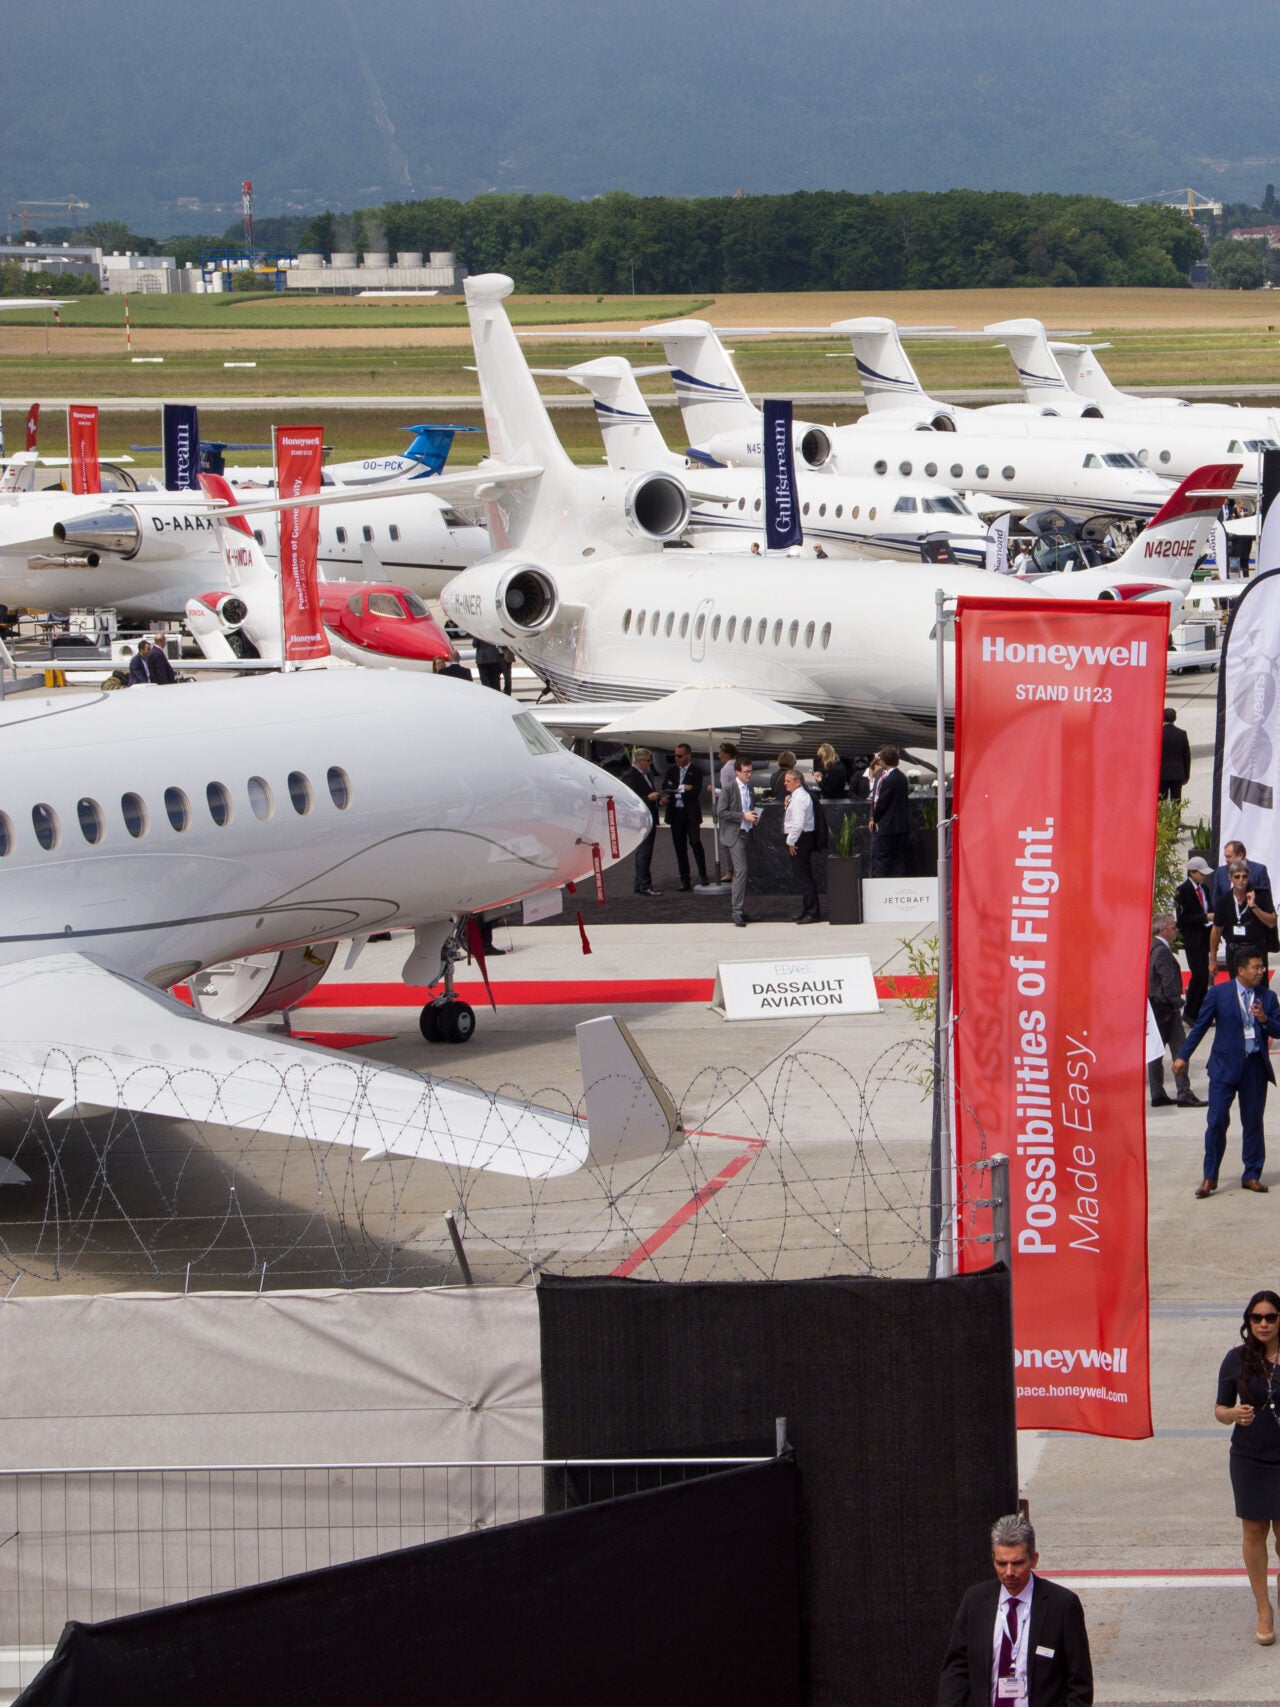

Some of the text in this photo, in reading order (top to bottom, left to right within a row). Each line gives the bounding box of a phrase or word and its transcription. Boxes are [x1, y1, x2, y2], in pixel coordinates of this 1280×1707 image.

[282, 437, 320, 447] Honeywell
[747, 443, 764, 454] N45
[363, 461, 404, 470] OO-PCK
[775, 419, 792, 533] Gulfstream
[290, 476, 304, 538] Connevity.
[1144, 539, 1197, 559] N420HE
[982, 636, 1147, 670] Honeywell
[1015, 684, 1113, 703] STAND U123
[1252, 675, 1266, 722] years
[883, 895, 931, 905] JETCRAFT
[752, 979, 845, 995] DASSAULT
[760, 993, 843, 1008] AVIATION
[1010, 817, 1060, 1254] Possibilities of Flight.
[1061, 1030, 1100, 1253] Made Easy.
[1016, 1385, 1128, 1403] pace.honeywell.com
